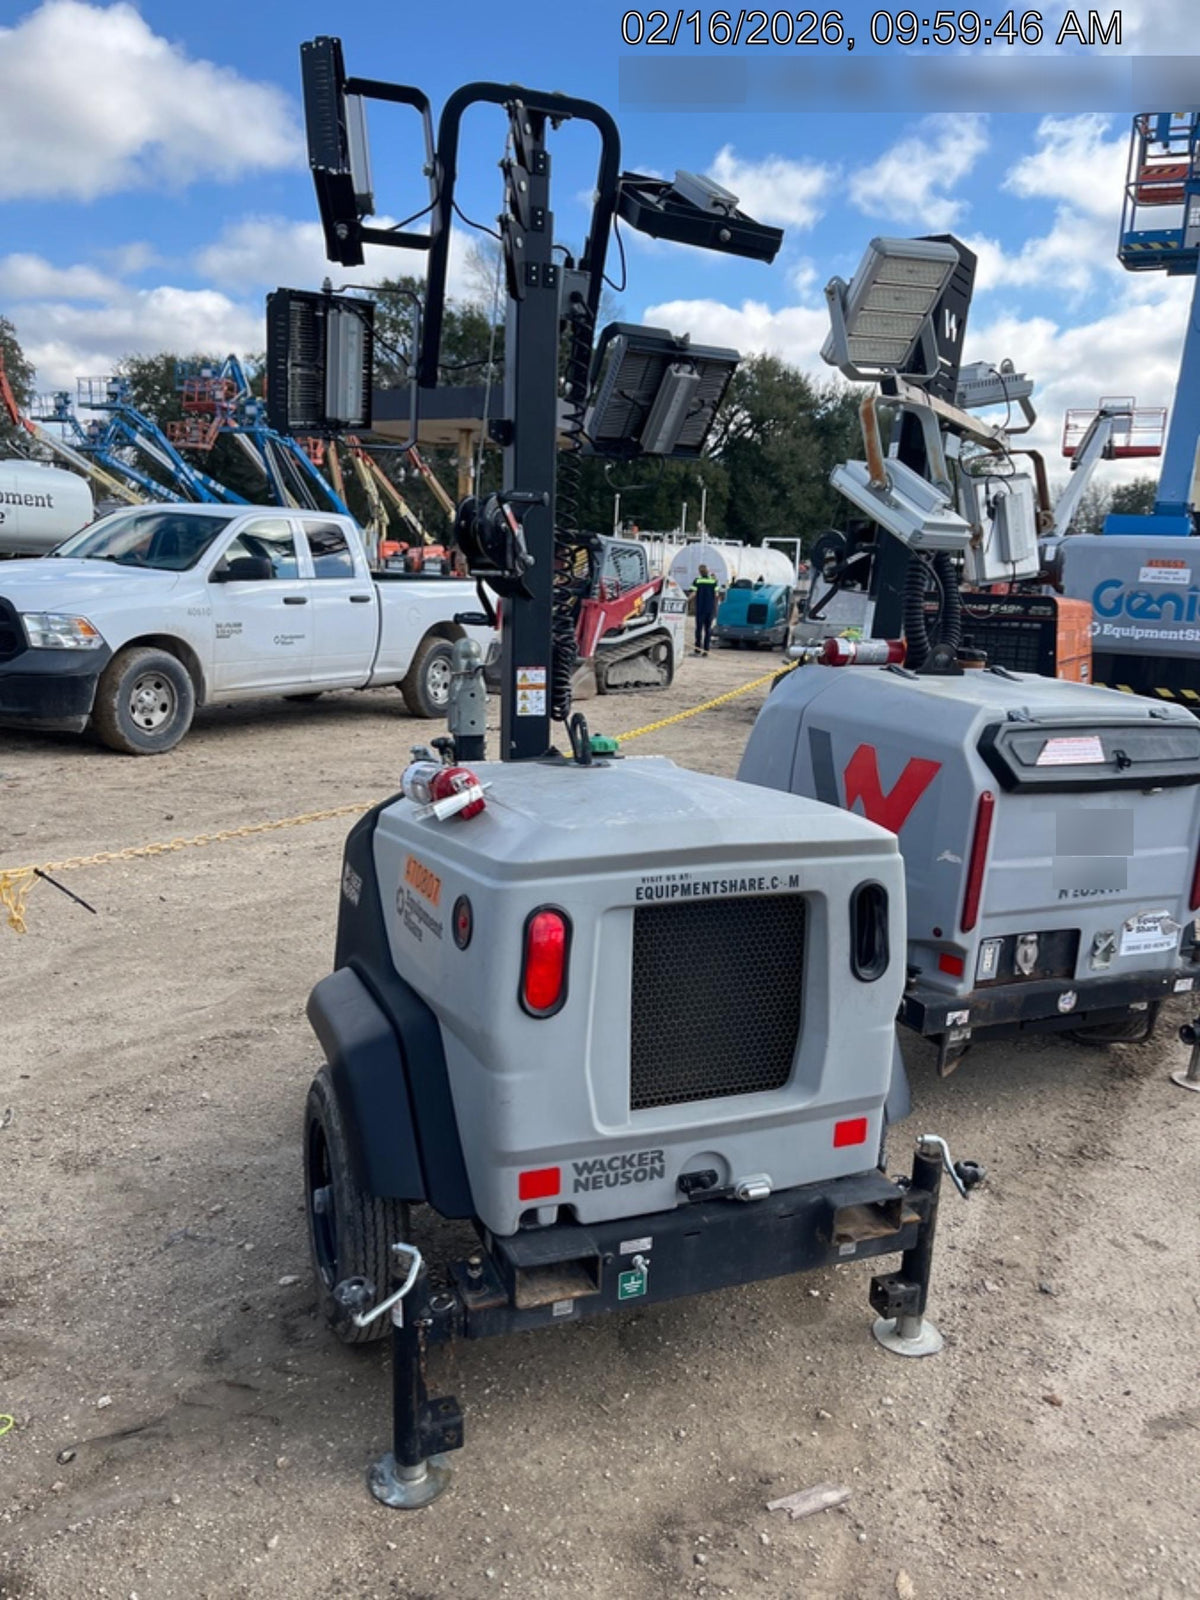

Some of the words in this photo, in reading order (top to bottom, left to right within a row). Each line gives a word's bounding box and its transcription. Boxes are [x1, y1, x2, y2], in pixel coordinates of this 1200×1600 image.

[1093, 579, 1200, 622] Geni
[635, 875, 800, 901] EQUIPMENTSHARE.CM
[572, 1149, 665, 1177] WACKER
[573, 1165, 665, 1193] NEUSON
